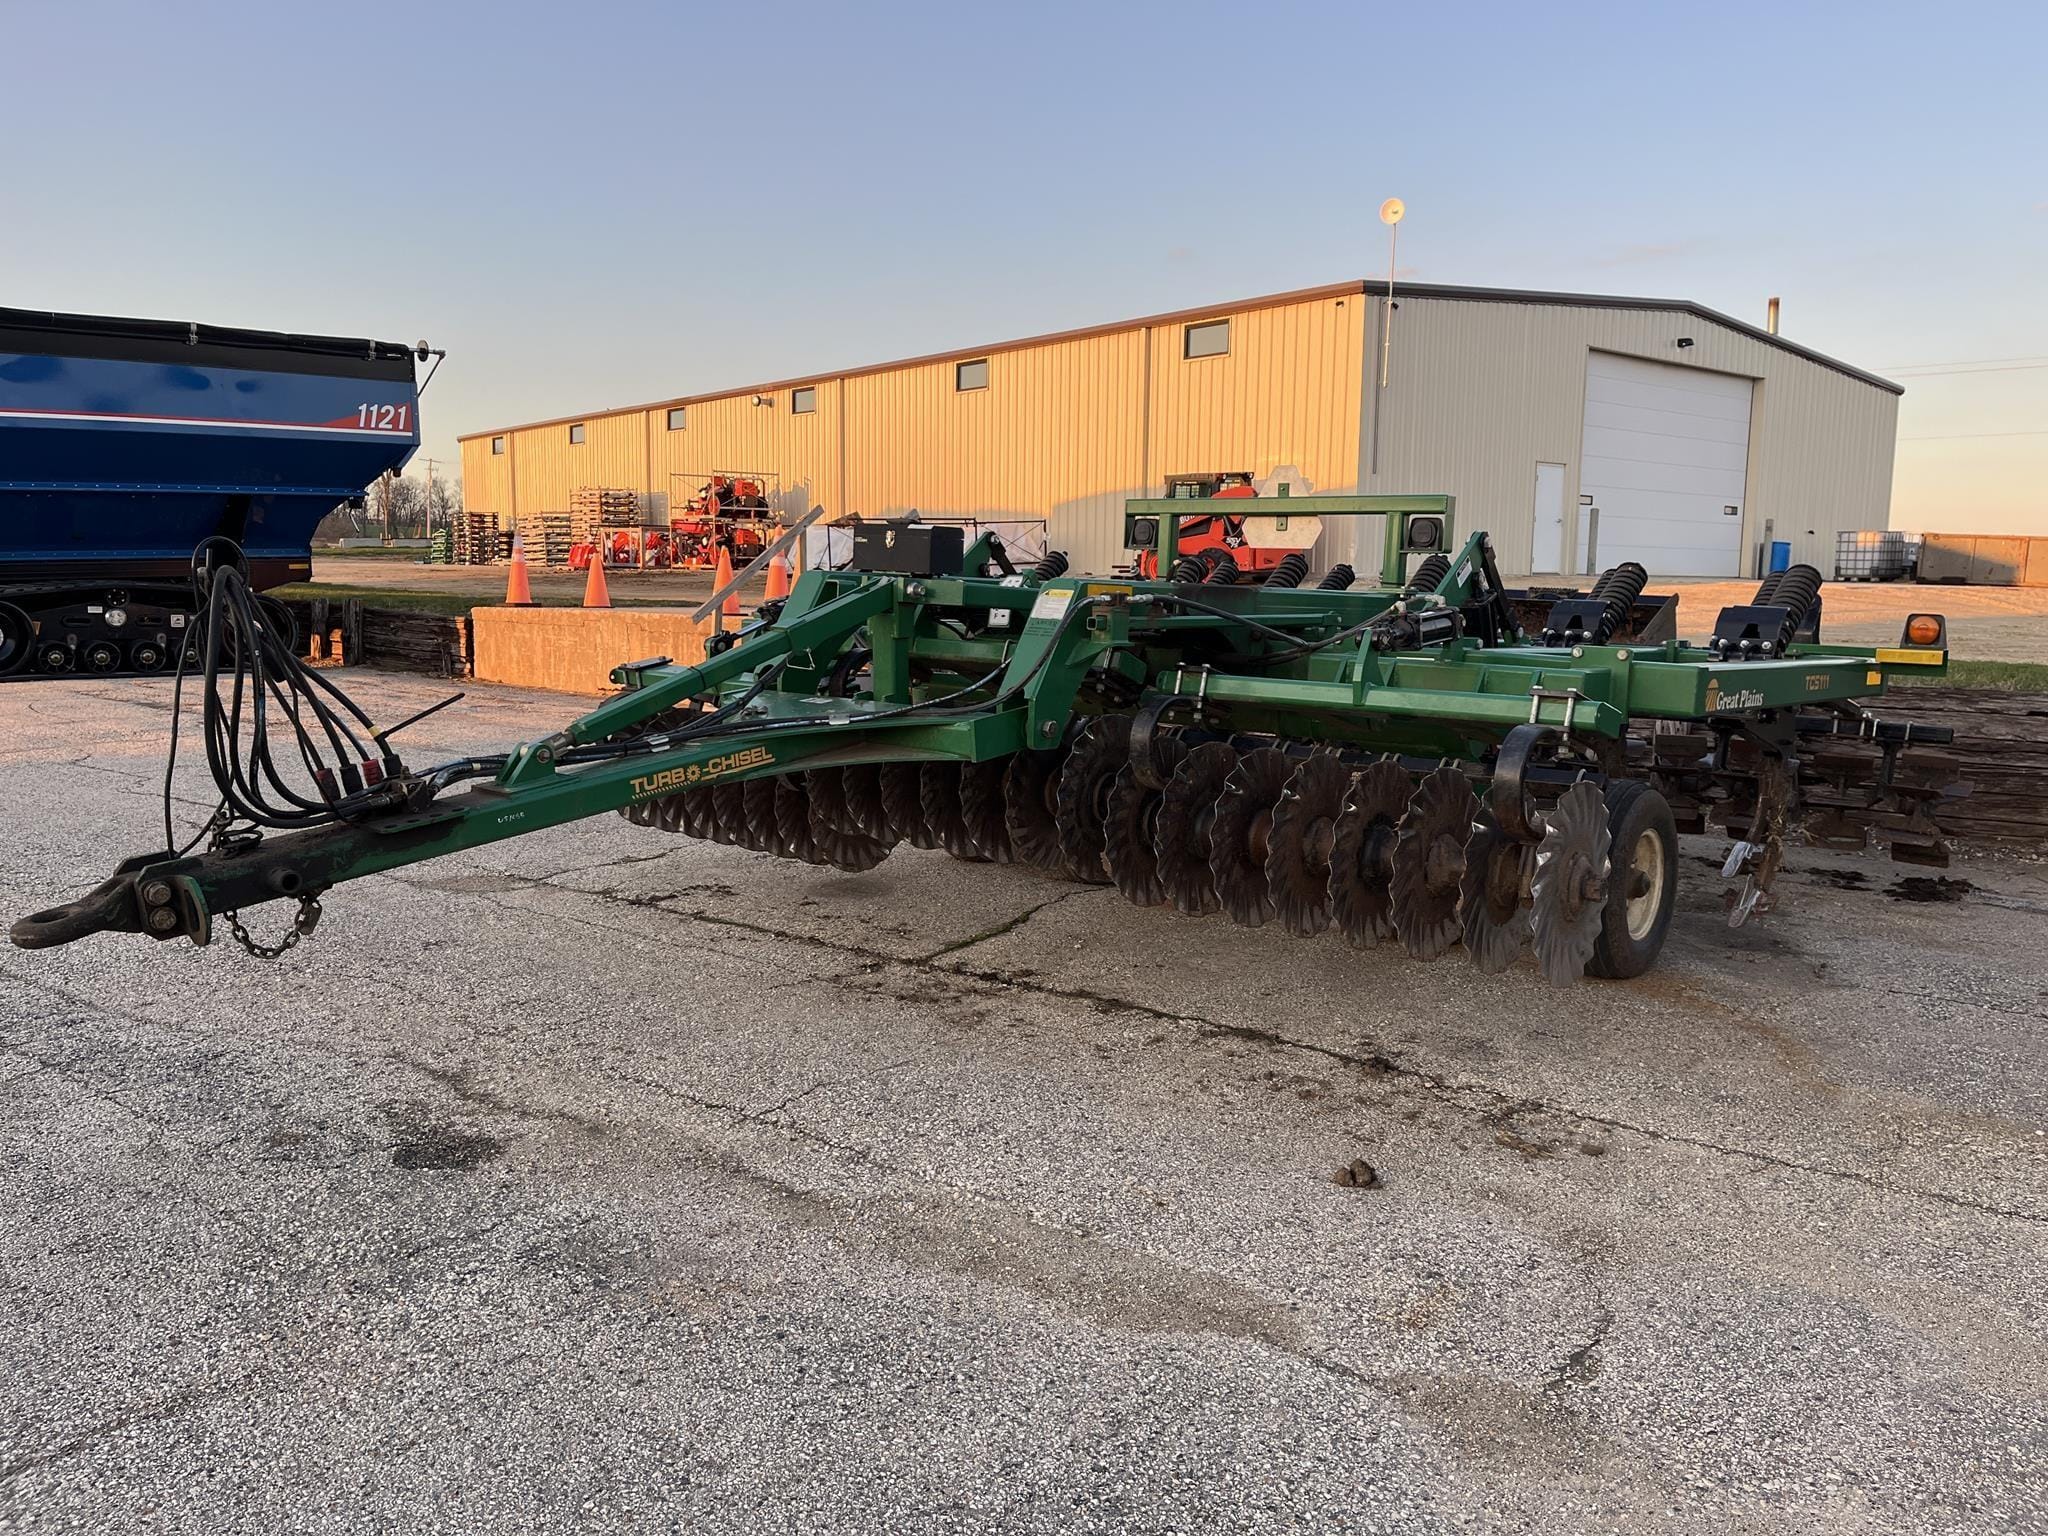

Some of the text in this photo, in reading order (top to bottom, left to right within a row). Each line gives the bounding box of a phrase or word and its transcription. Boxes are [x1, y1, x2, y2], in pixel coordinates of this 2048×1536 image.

[358, 403, 407, 430] 1121
[1716, 688, 1764, 710] Great Plains
